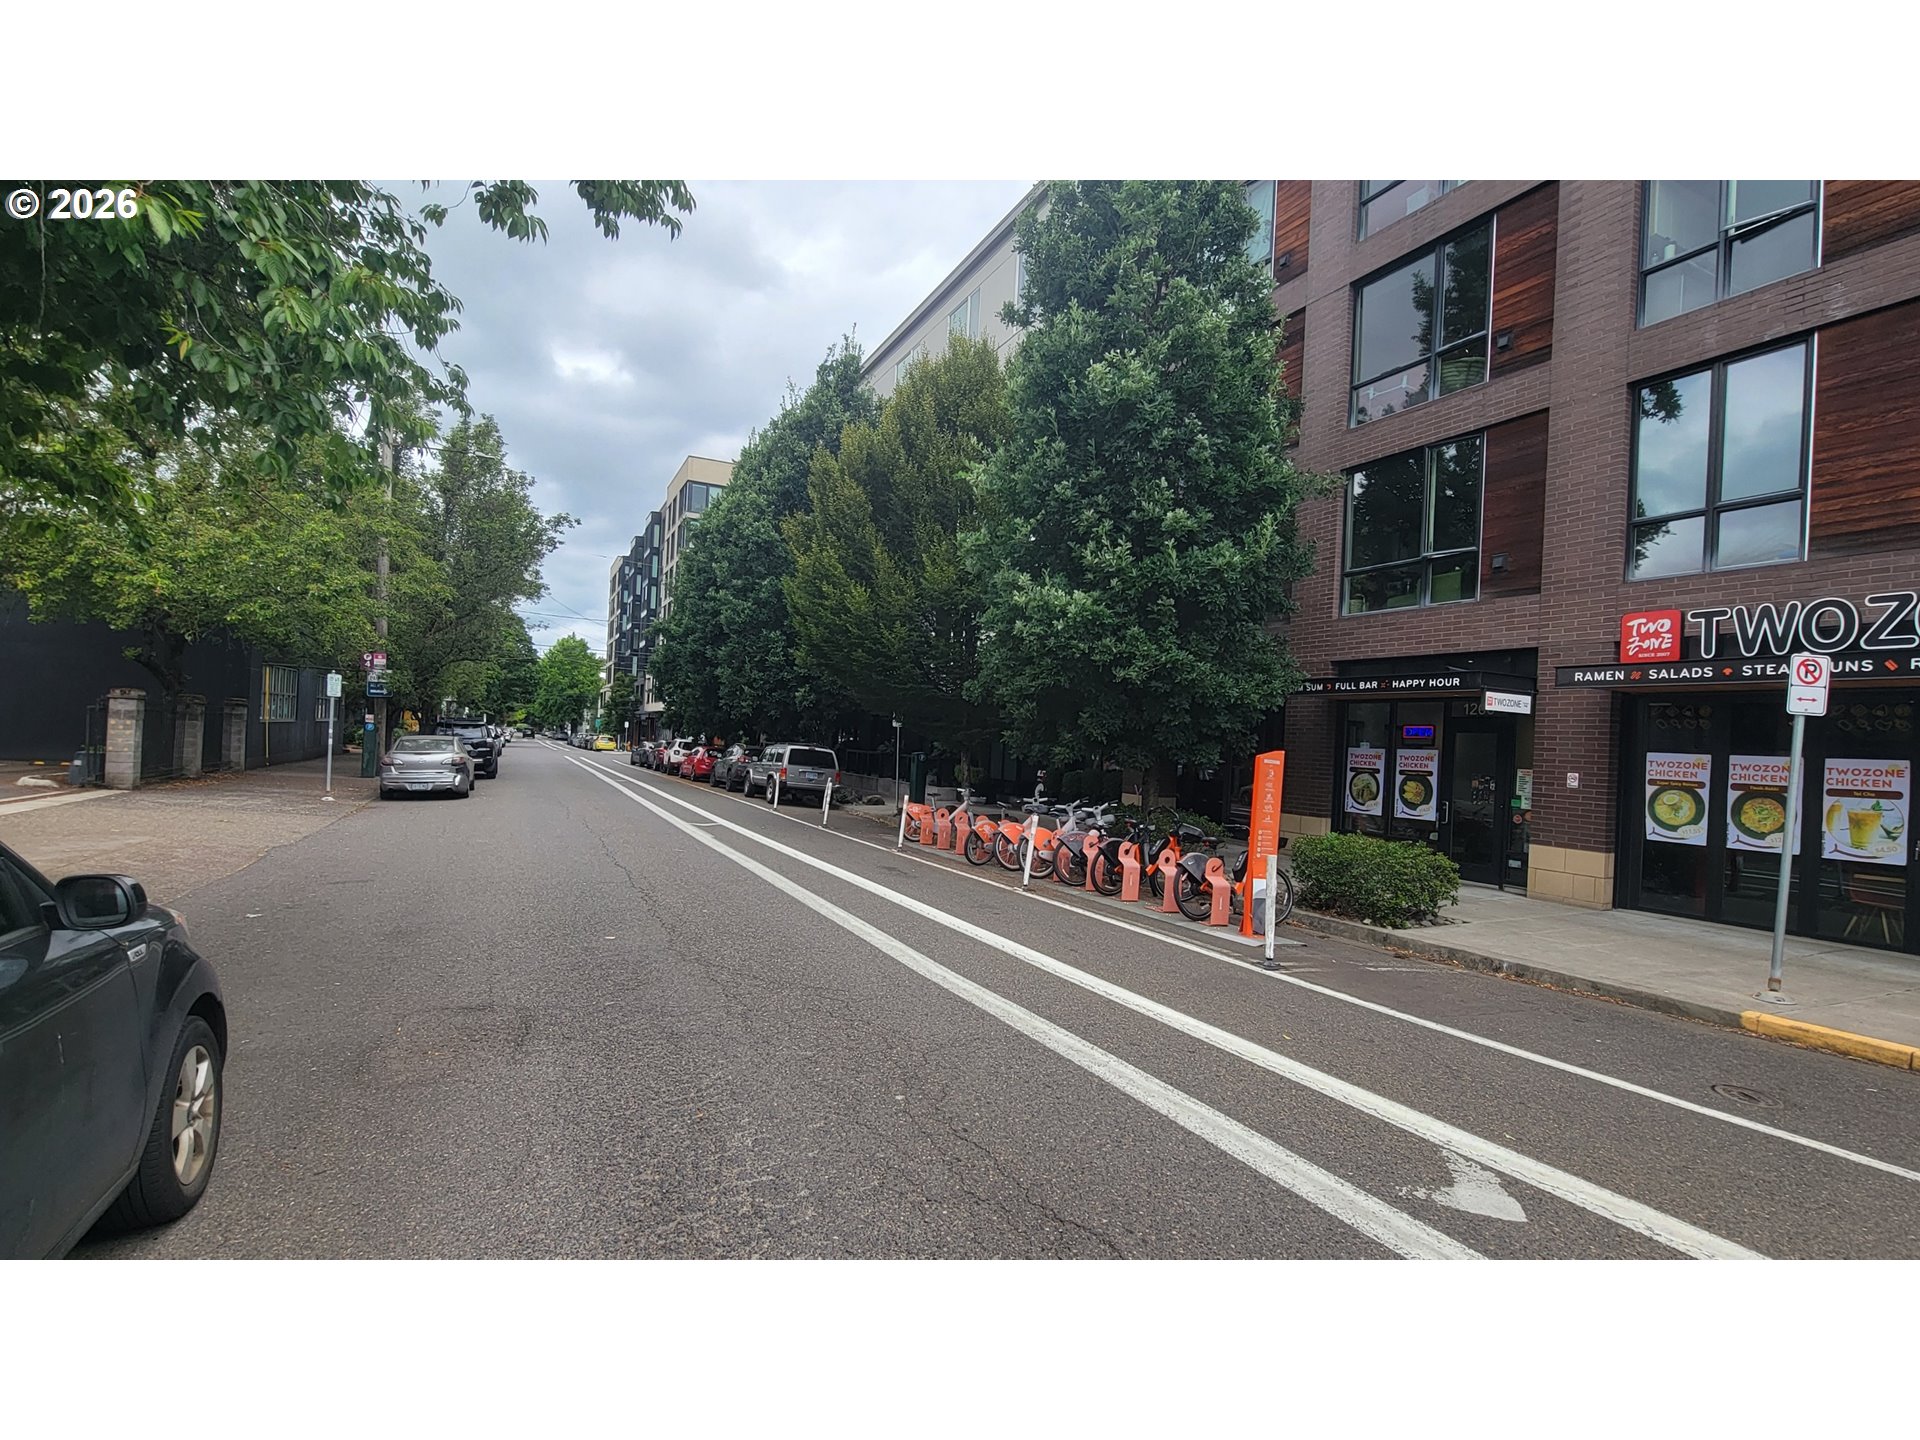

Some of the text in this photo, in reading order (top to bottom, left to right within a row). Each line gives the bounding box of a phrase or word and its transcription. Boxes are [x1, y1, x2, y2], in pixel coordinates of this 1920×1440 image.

[1688, 591, 1920, 659] TWOZ
[1575, 670, 1625, 682] RAMEN
[1648, 666, 1713, 680] SALADS
[1742, 663, 1791, 676] STEA
[1830, 659, 1874, 673] UNS
[1306, 683, 1323, 692] SUM
[1335, 682, 1357, 690] FULL
[1359, 680, 1378, 690] BAR
[1392, 678, 1426, 688] HAPPY
[1429, 677, 1460, 687] HOUR
[1494, 698, 1522, 709] TWOZONE
[1350, 753, 1382, 761] TWOZONE
[1399, 755, 1434, 763] TWOZONE
[1648, 760, 1708, 770] TWOZONE
[1731, 763, 1790, 773] TWOZON
[1648, 769, 1698, 779] CHICKEN
[1826, 767, 1905, 778] TWOZONE
[1730, 773, 1788, 783] CHICKEN
[1826, 778, 1892, 788] CHICKEN
